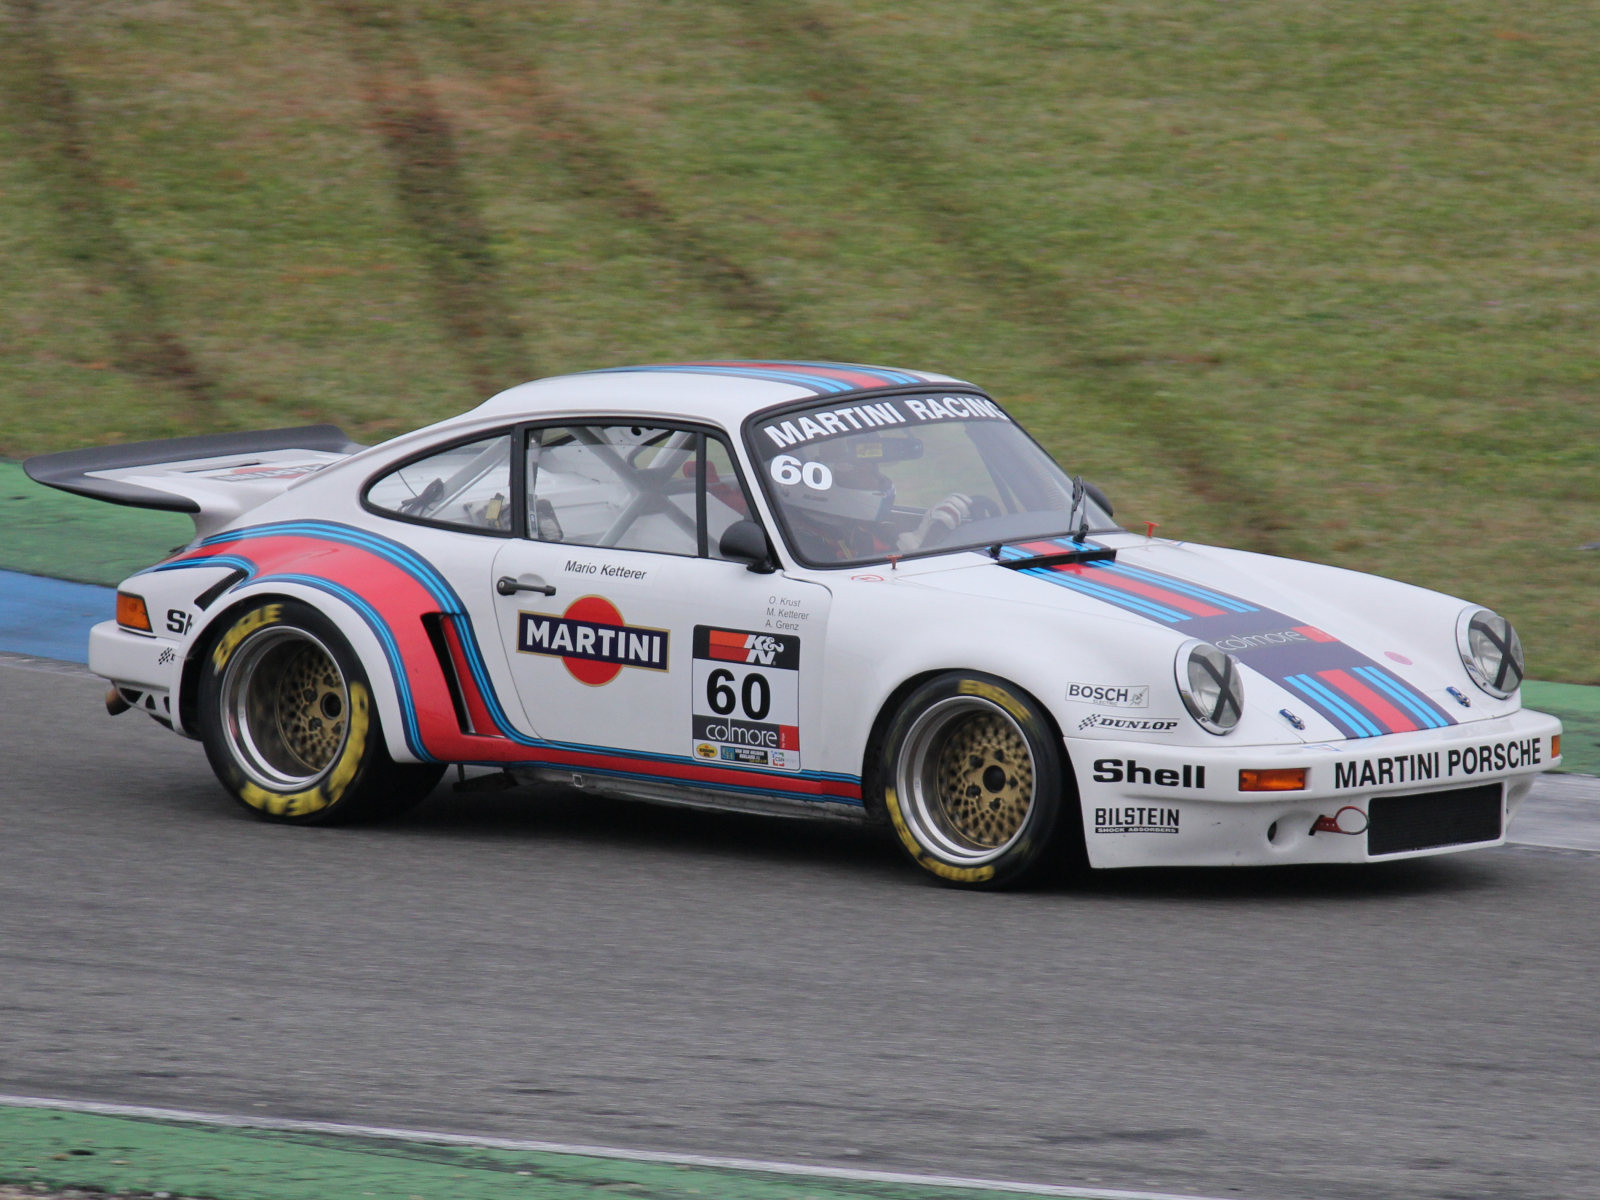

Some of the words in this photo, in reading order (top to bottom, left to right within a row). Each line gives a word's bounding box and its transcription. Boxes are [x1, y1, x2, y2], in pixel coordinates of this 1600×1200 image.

[764, 402, 906, 449] MARTINI
[770, 454, 833, 491] 60
[565, 560, 597, 574] Mario
[600, 564, 647, 580] Ketterer
[768, 595, 778, 605] O.
[780, 597, 801, 607] Krust
[766, 607, 776, 617] M.
[778, 609, 809, 620] Ketterer
[765, 619, 774, 628] A.
[775, 620, 800, 630] Grenz
[526, 618, 661, 663] MARTINI
[1215, 634, 1308, 651] colmore
[706, 668, 771, 721] 60
[1069, 684, 1129, 702] BOSCH
[706, 718, 778, 747] colmore
[1099, 718, 1178, 730] DUNLOP
[1335, 751, 1440, 789] MARTINI
[1447, 737, 1542, 776] PORSCHE
[1092, 758, 1206, 789] Shell
[1095, 807, 1180, 826] BILSTEIN
